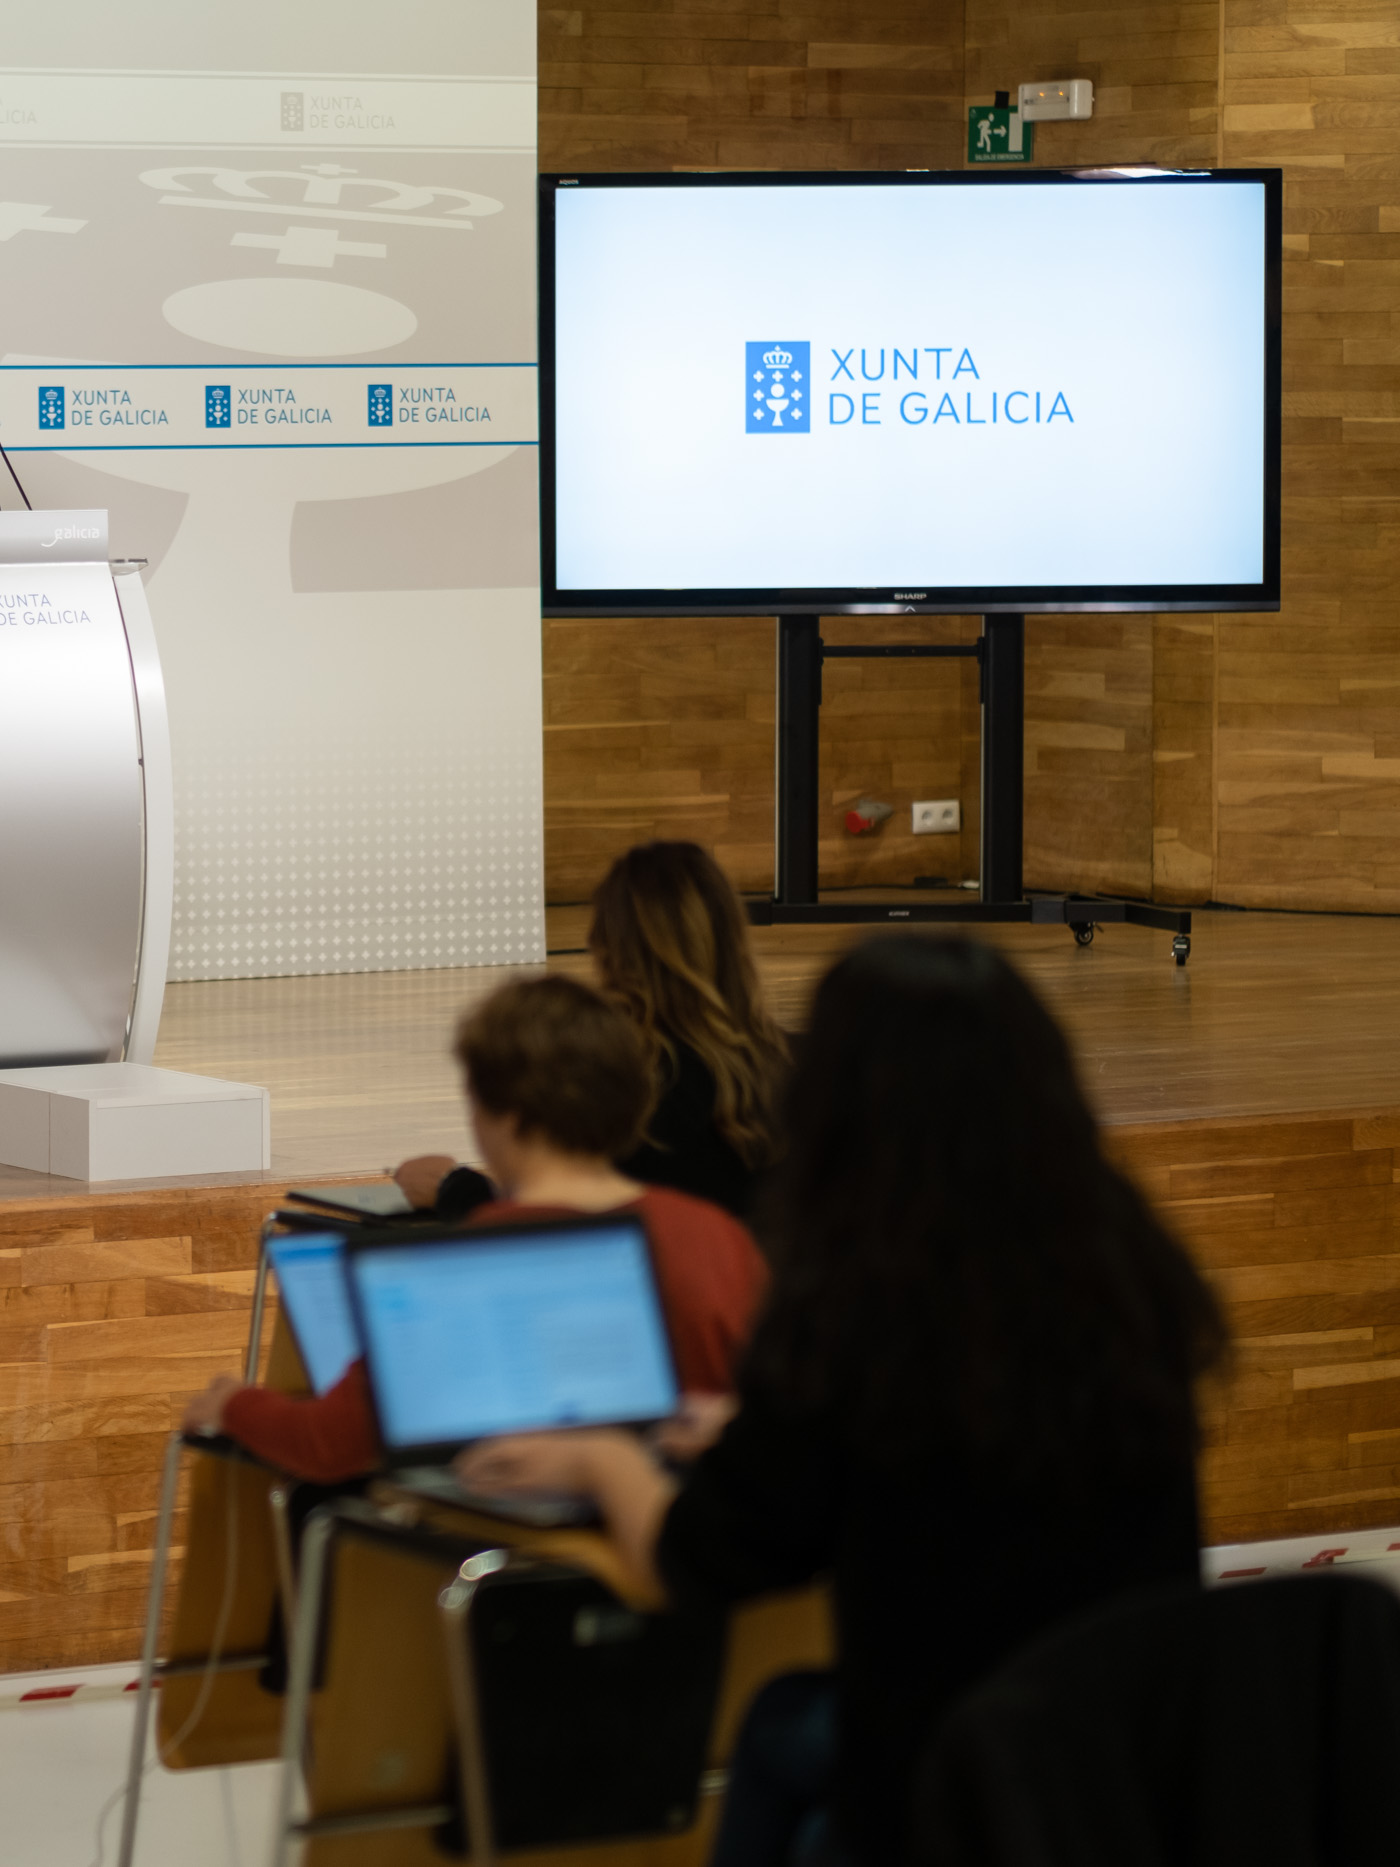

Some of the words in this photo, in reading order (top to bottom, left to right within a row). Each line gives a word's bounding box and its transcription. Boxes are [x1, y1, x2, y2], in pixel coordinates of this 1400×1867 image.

[310, 96, 364, 111] XUNTA
[309, 114, 329, 129] DE
[334, 114, 396, 130] GALICIA
[830, 347, 980, 381] XUNTA
[72, 389, 132, 406] XUNTA
[238, 388, 297, 405] XUNTA
[399, 387, 457, 404] XUNTA
[399, 407, 420, 423] DE
[425, 406, 492, 423] GALICIA
[829, 392, 882, 425] DE
[899, 390, 1075, 425] GALICIA
[71, 410, 93, 426] DE
[99, 410, 169, 426] GALICIA
[237, 408, 259, 424] DE
[264, 408, 332, 425] GALICIA
[43, 524, 101, 545] galicia
[893, 592, 928, 601] SHARP
[23, 610, 91, 626] GALICIA
